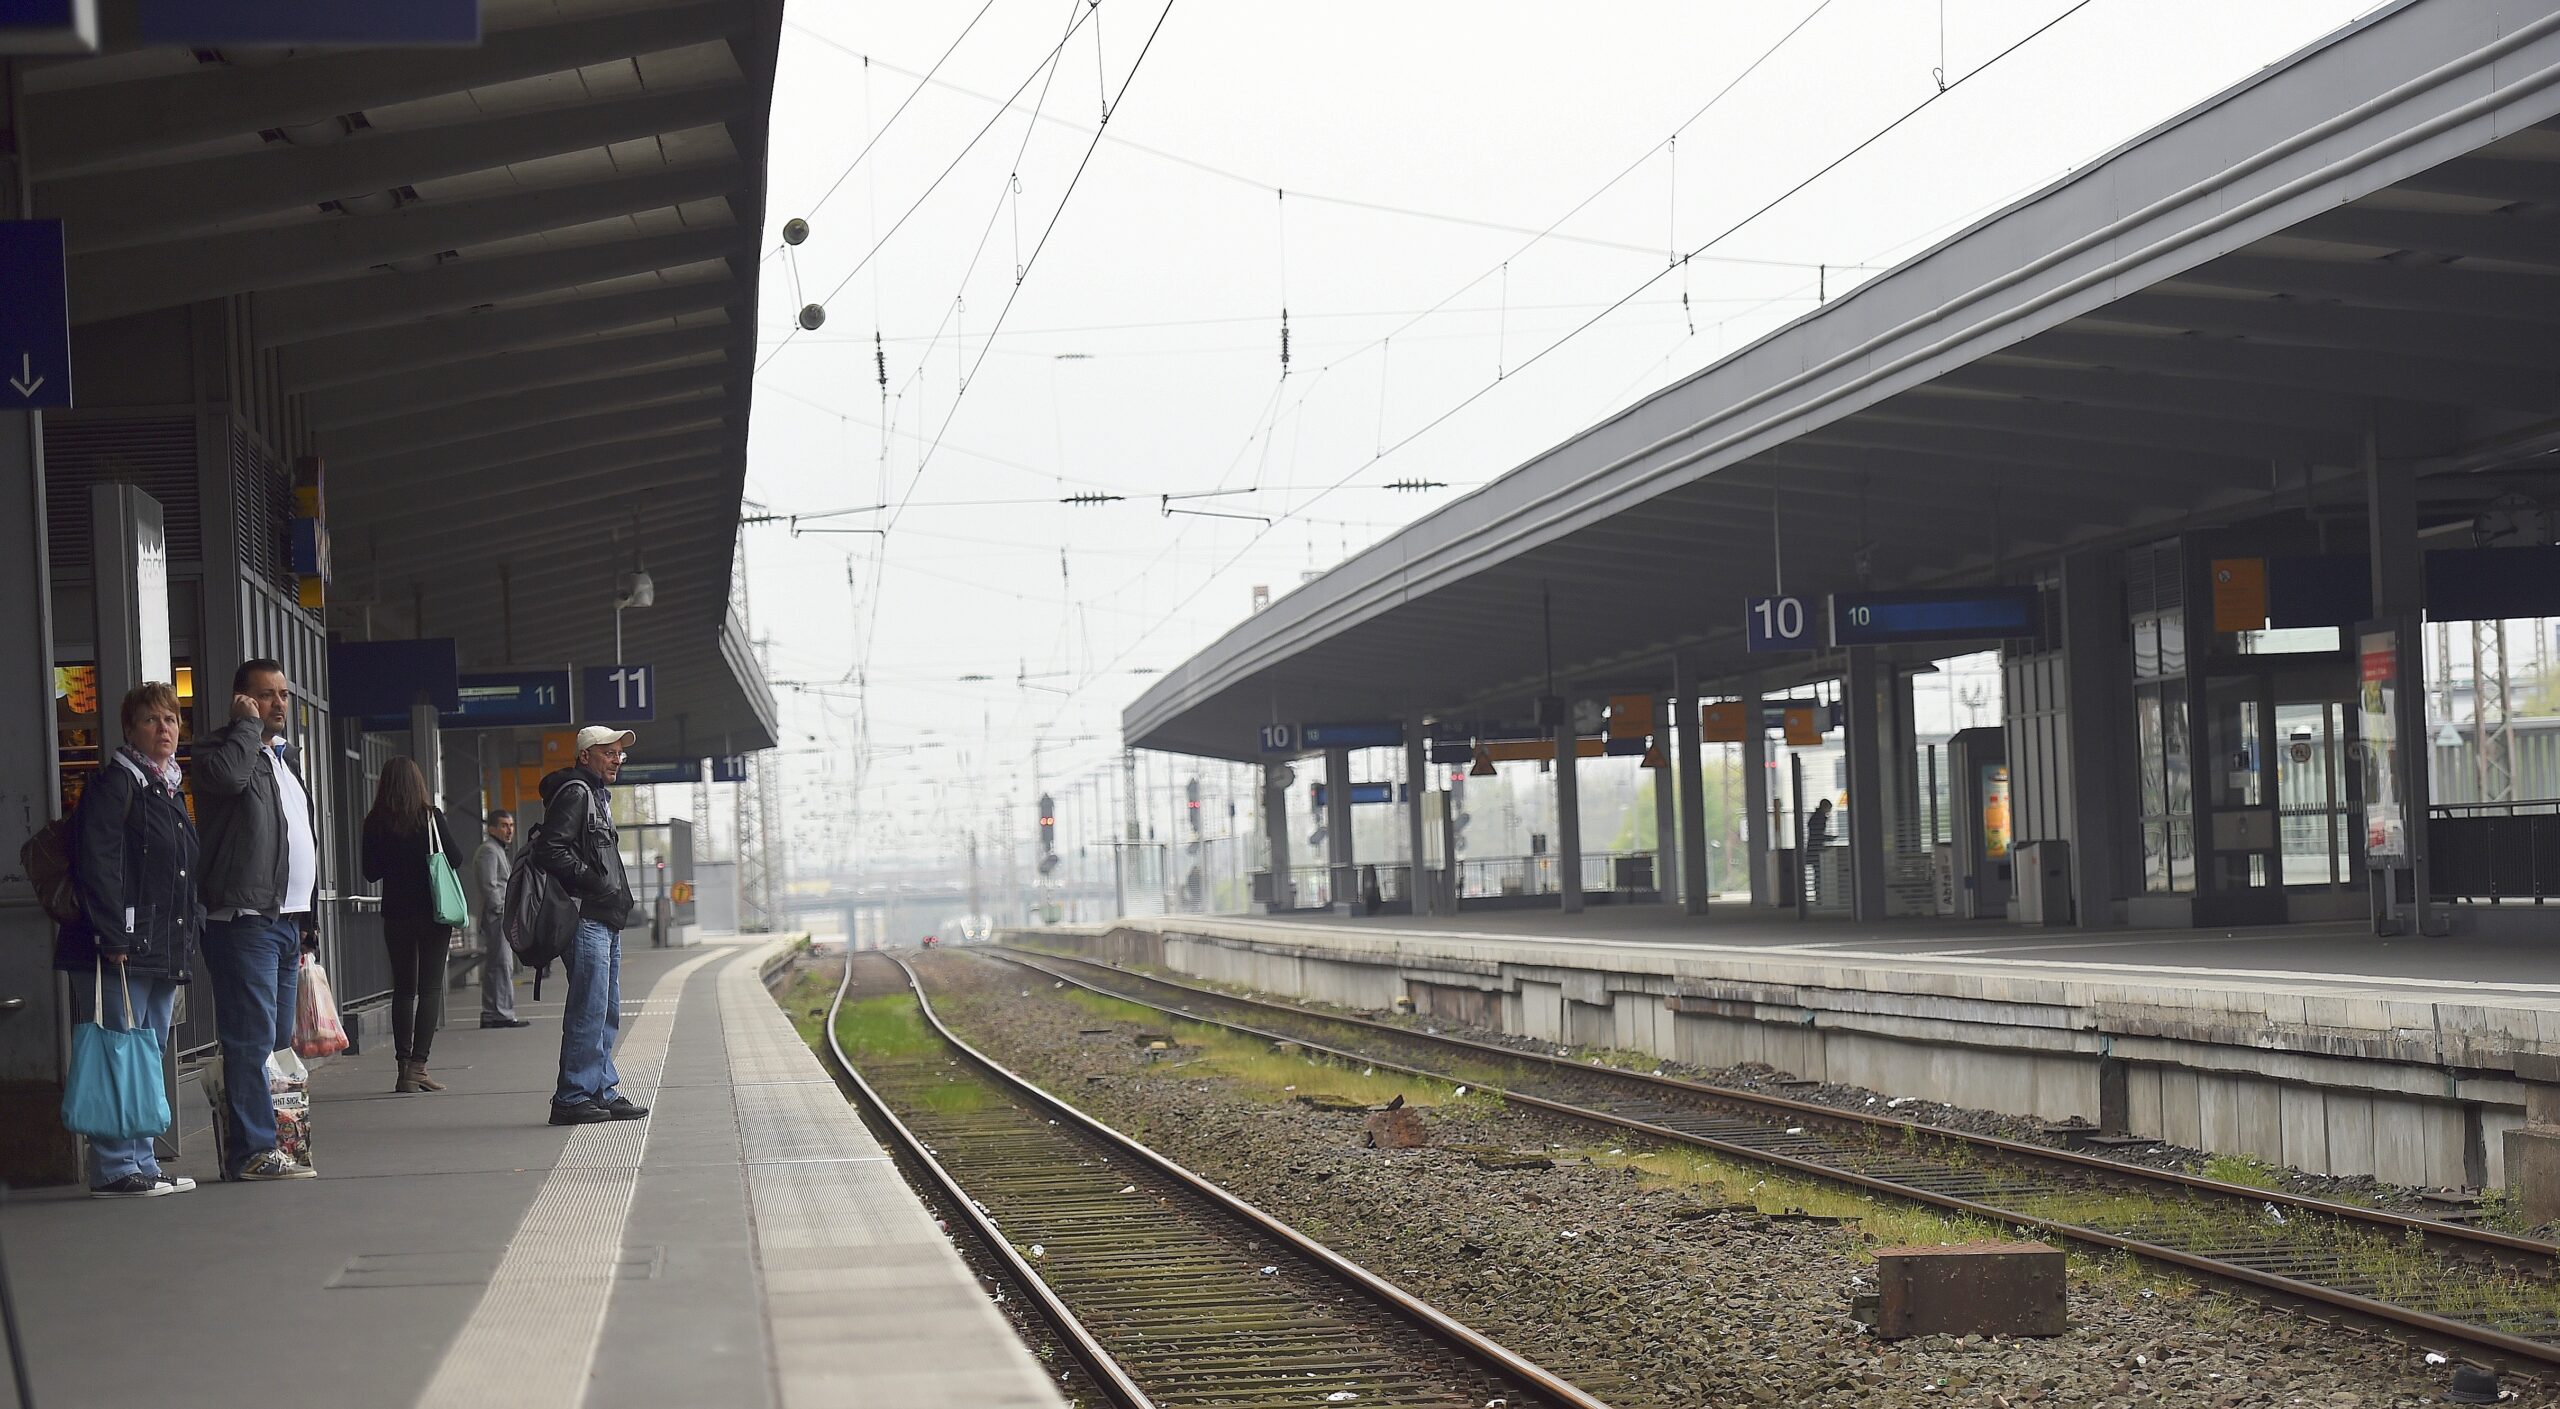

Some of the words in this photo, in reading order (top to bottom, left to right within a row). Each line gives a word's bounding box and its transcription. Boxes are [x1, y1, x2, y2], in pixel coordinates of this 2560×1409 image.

[1755, 597, 1803, 639] 10
[1848, 606, 1871, 626] 10
[534, 685, 556, 705] 11
[608, 667, 647, 709] 11
[1262, 724, 1289, 748] 10
[723, 756, 745, 777] 11
